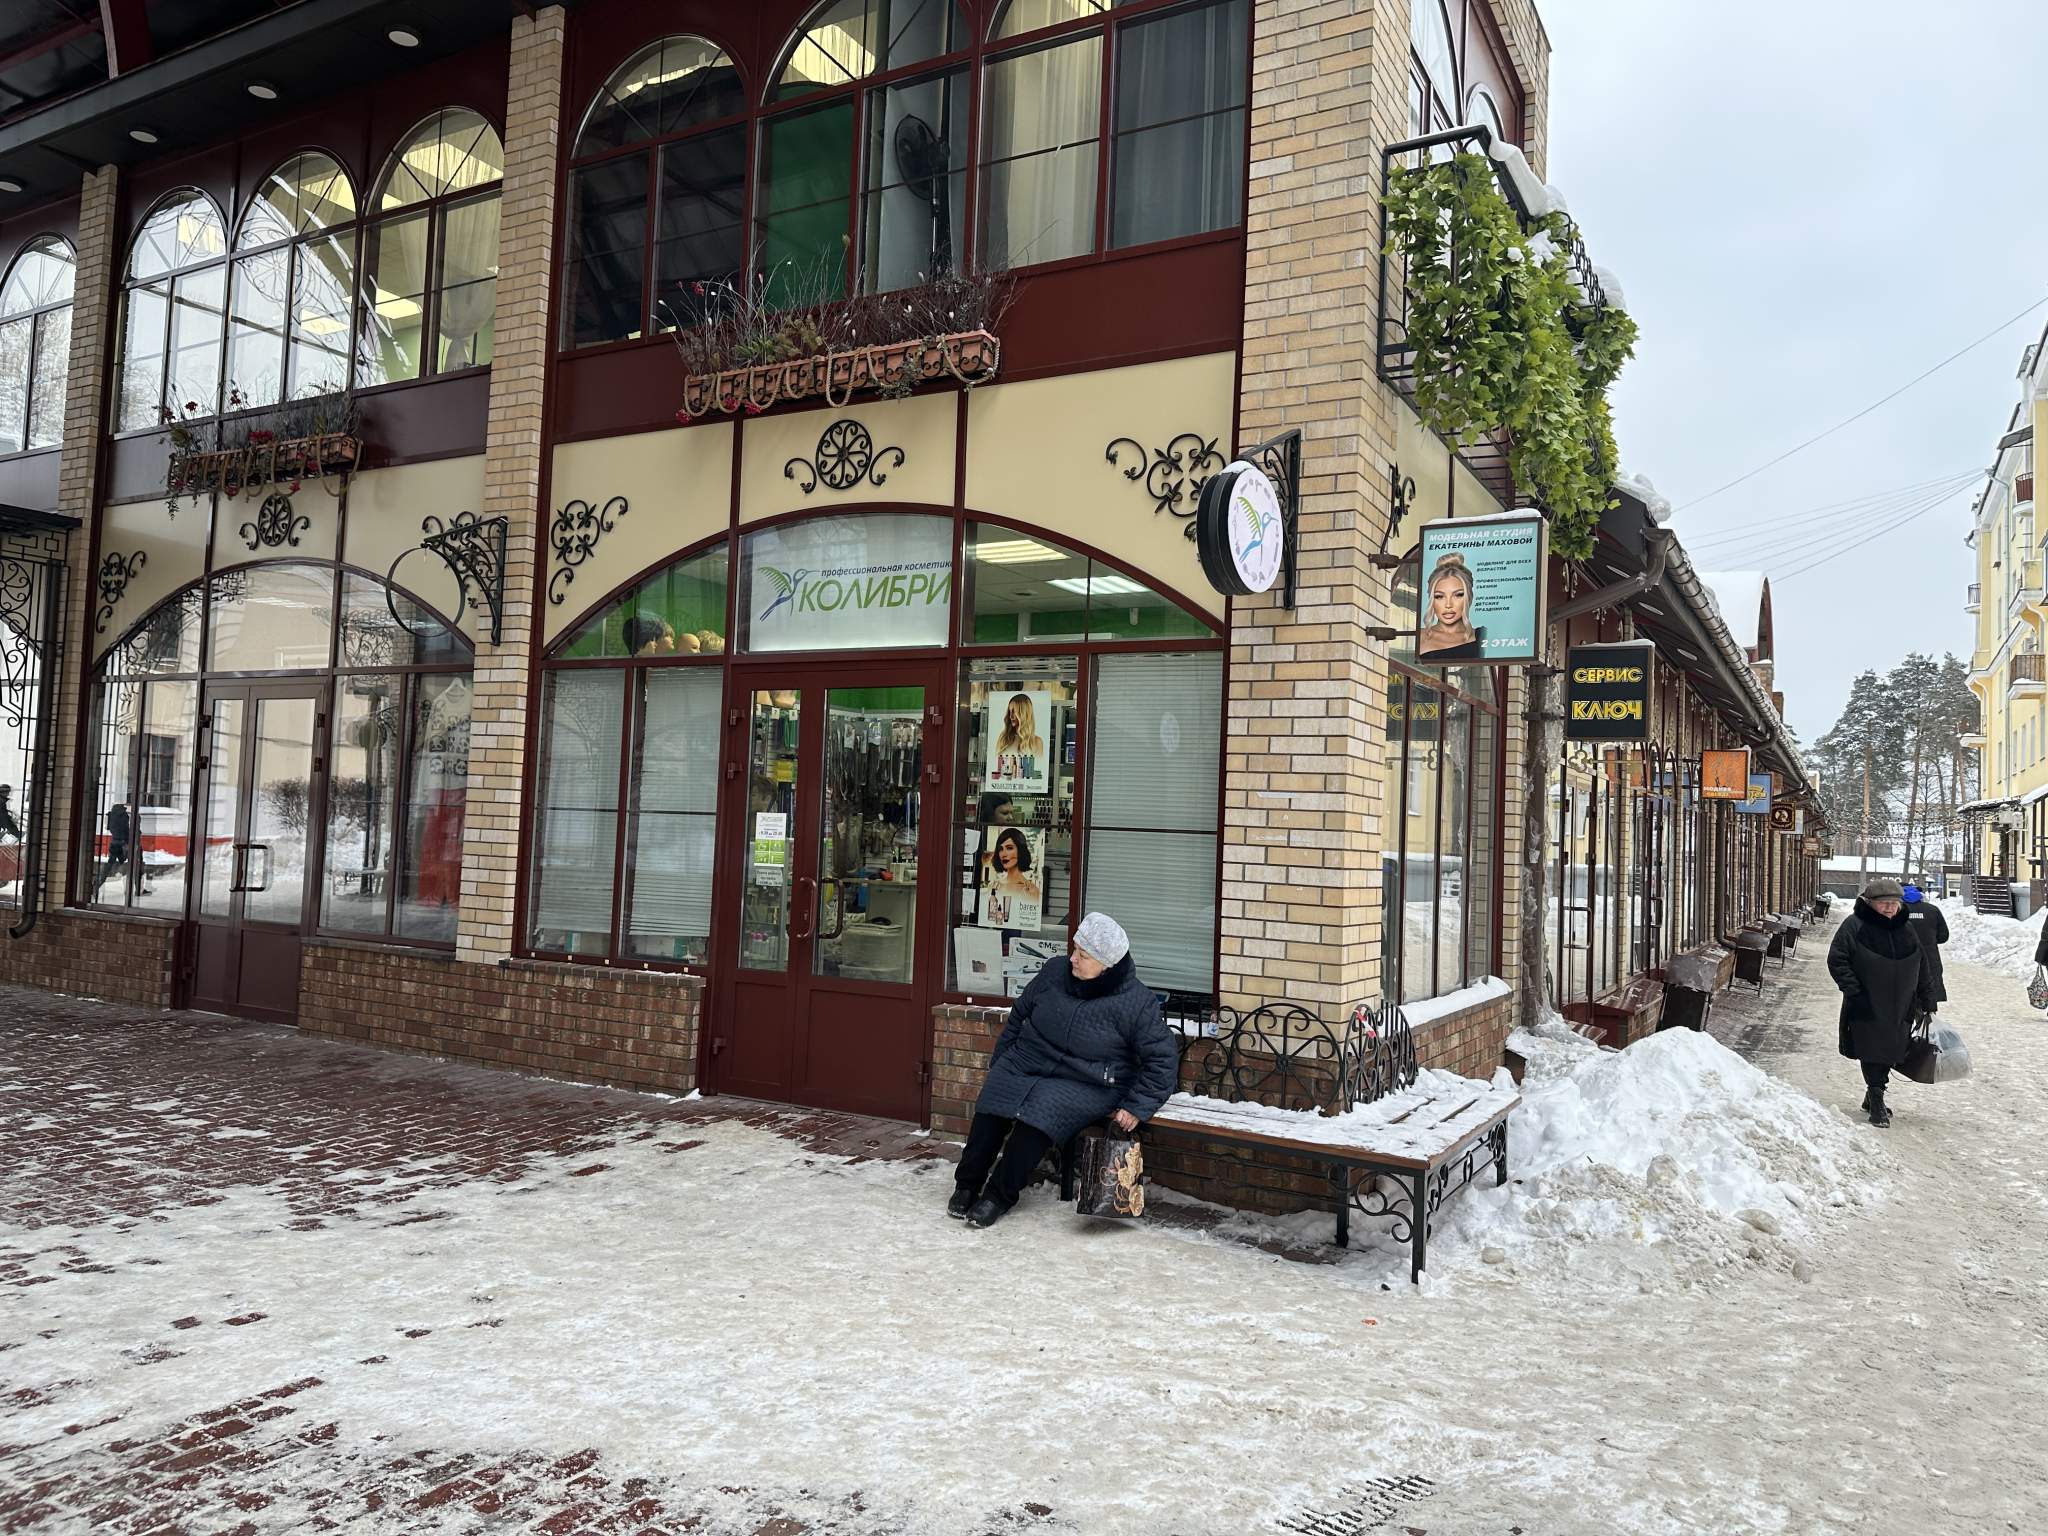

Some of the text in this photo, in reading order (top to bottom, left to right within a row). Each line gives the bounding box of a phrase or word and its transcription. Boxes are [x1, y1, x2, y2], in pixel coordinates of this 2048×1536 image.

[1429, 527, 1534, 542] МОДЕЛЬНАЯ СТУДИЯ
[1428, 537, 1533, 551] ЕКАТЕРИНЫ МАХОВОЙ
[821, 563, 903, 578] профессиональная
[799, 571, 952, 612] КОЛИБРИ
[1481, 637, 1528, 648] 2 ЭТАЖ
[1573, 666, 1643, 684] СЕРВИС
[1571, 699, 1643, 720] КЛЮЧ
